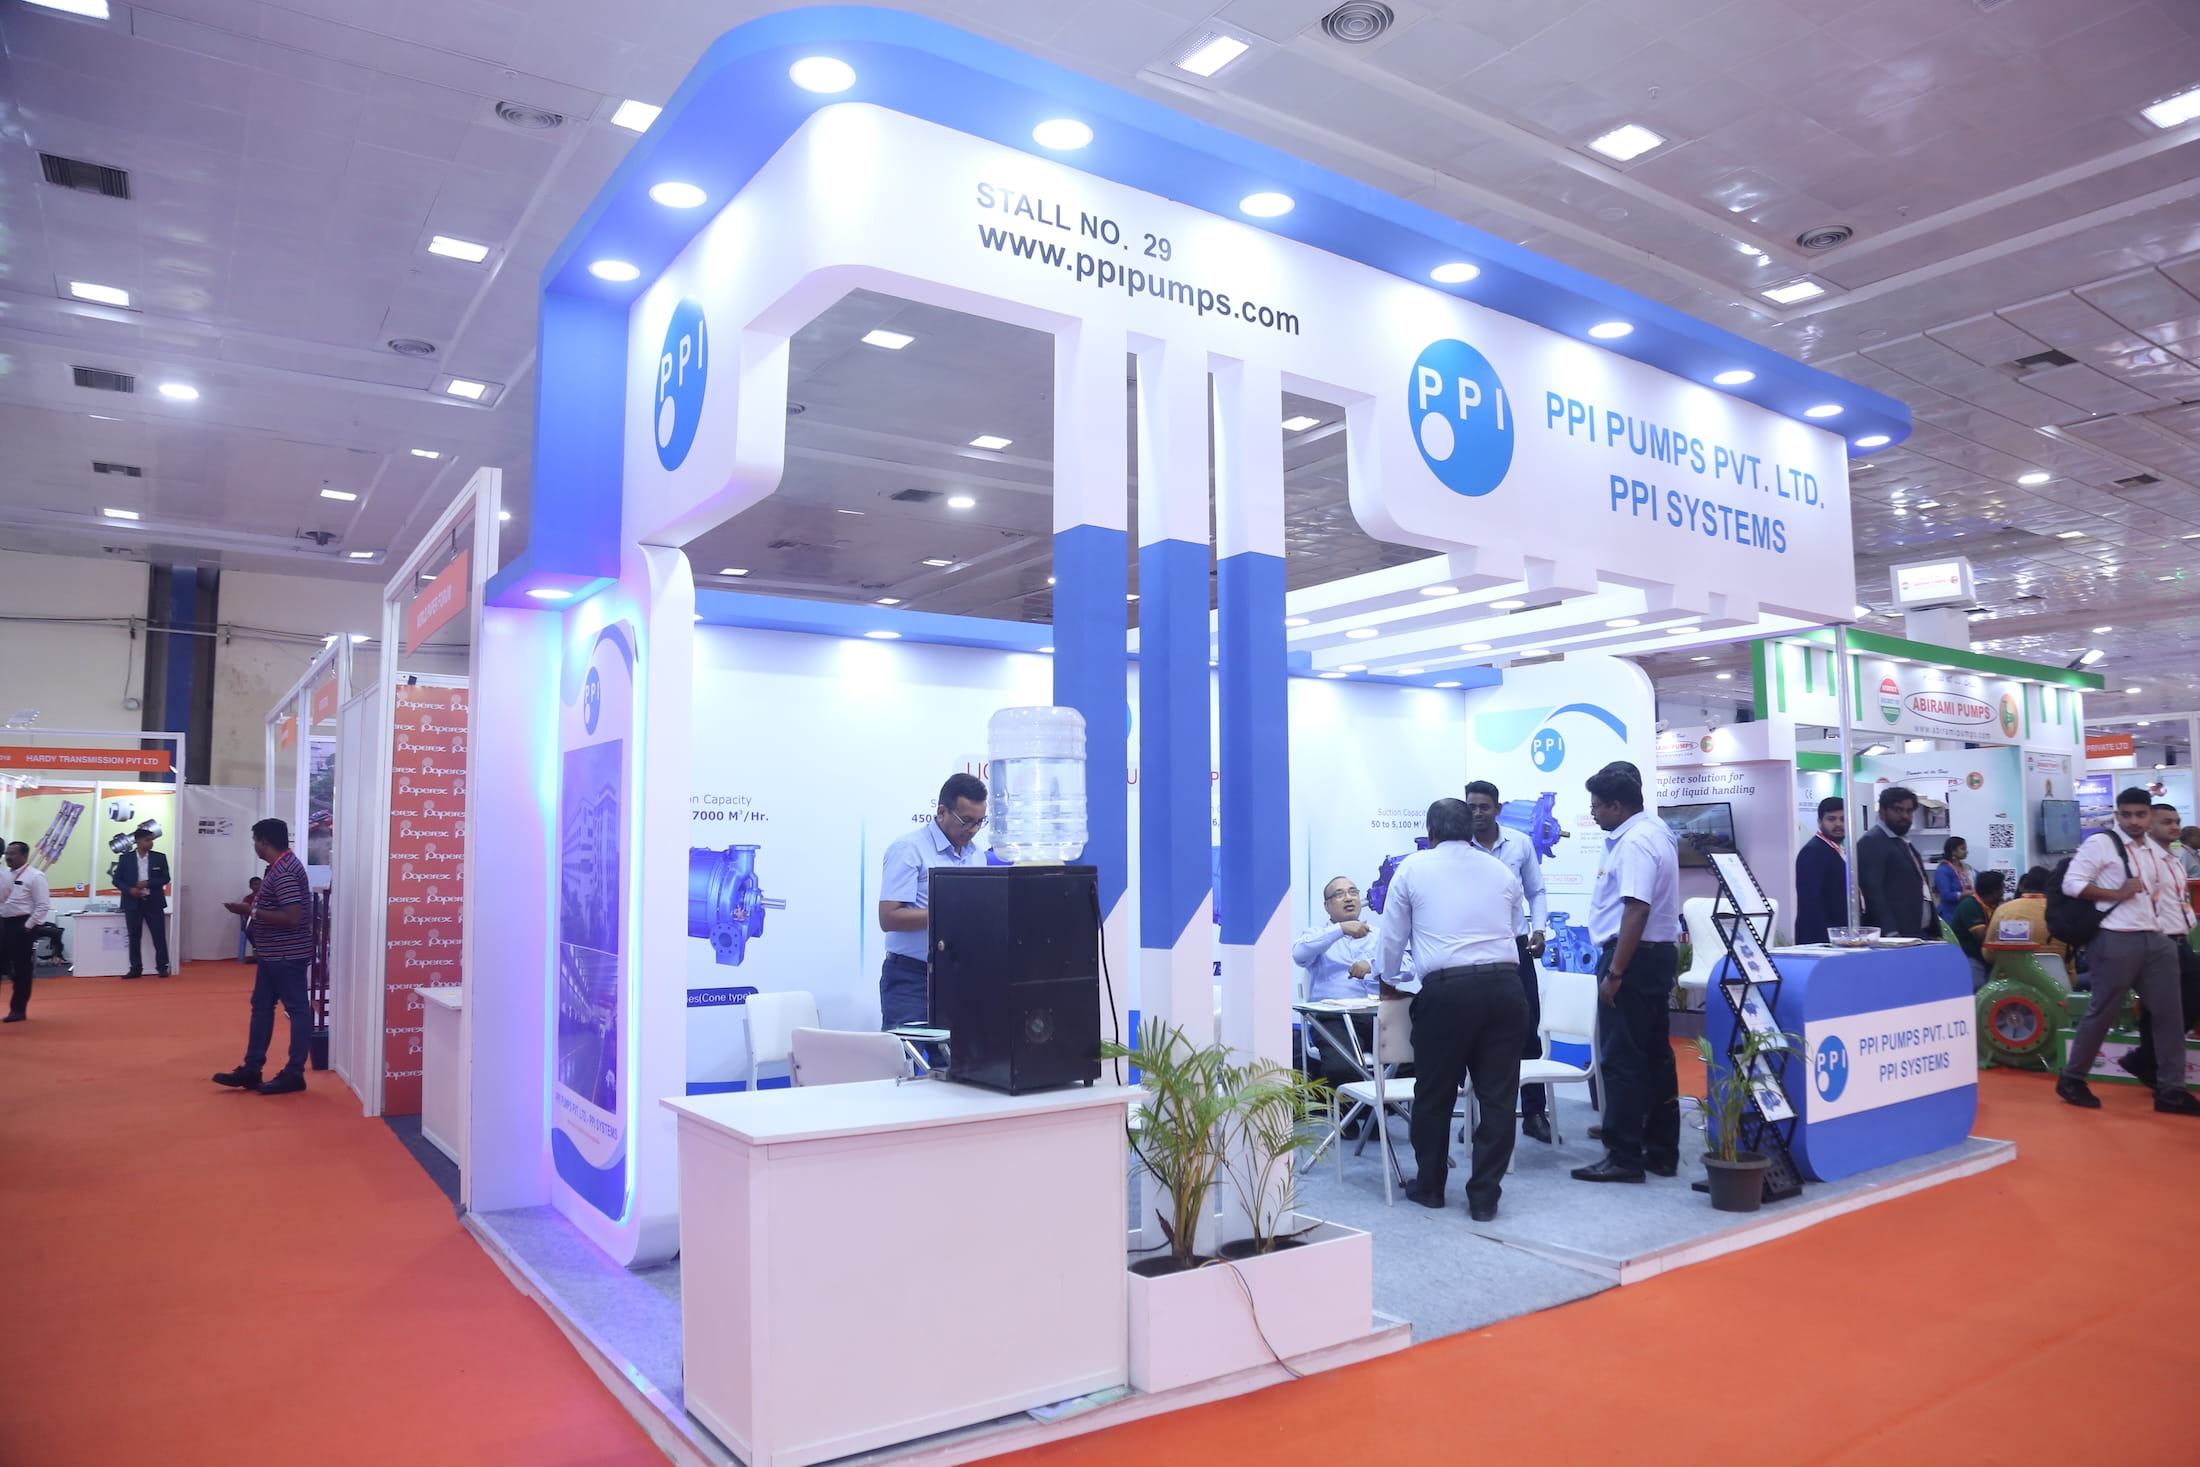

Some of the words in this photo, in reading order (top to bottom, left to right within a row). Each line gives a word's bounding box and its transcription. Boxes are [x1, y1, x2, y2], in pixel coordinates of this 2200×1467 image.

[976, 182, 1071, 231] STALL
[1080, 211, 1128, 251] NO.
[1143, 233, 1172, 262] 29
[978, 224, 1300, 336] www.ppipumps.com
[660, 320, 704, 403] PPI
[1417, 364, 1505, 430] PPI
[1546, 391, 1596, 442] PPI
[1607, 410, 1706, 474] PUMPS
[1714, 445, 1769, 492] PVT.
[1776, 467, 1825, 509] LTD.
[1609, 474, 1658, 521] PPI
[1667, 489, 1787, 554] SYSTEMS
[1912, 697, 1955, 715] ABIRAMI
[1957, 701, 1991, 720] PUMPS
[1534, 737, 1562, 753] PPI
[2087, 743, 2115, 752] PRIVATE
[2116, 742, 2129, 750] LTD
[26, 754, 58, 763] HARDY
[59, 755, 124, 765] TRANSMISSION
[125, 757, 142, 765] PVT
[143, 757, 159, 766] LTD
[1687, 773, 1727, 784] solution
[1728, 771, 1745, 784] for
[703, 794, 752, 807] Capacity
[1670, 787, 1681, 799] of
[1682, 786, 1709, 799] liquid
[1712, 784, 1756, 796] handling
[692, 810, 724, 821] 7000
[1371, 820, 1381, 828] 50
[1382, 820, 1390, 828] to
[1391, 820, 1412, 829] 5,100
[1859, 1036, 1879, 1056] PPI
[1881, 1028, 1920, 1051] PUMPS
[1923, 1025, 1945, 1044] PVT.
[1947, 1020, 1970, 1039] LTD.
[1817, 1049, 1846, 1073] PPI
[1879, 1063, 1898, 1083] PPI
[1900, 1052, 1950, 1078] SYSTEMS
